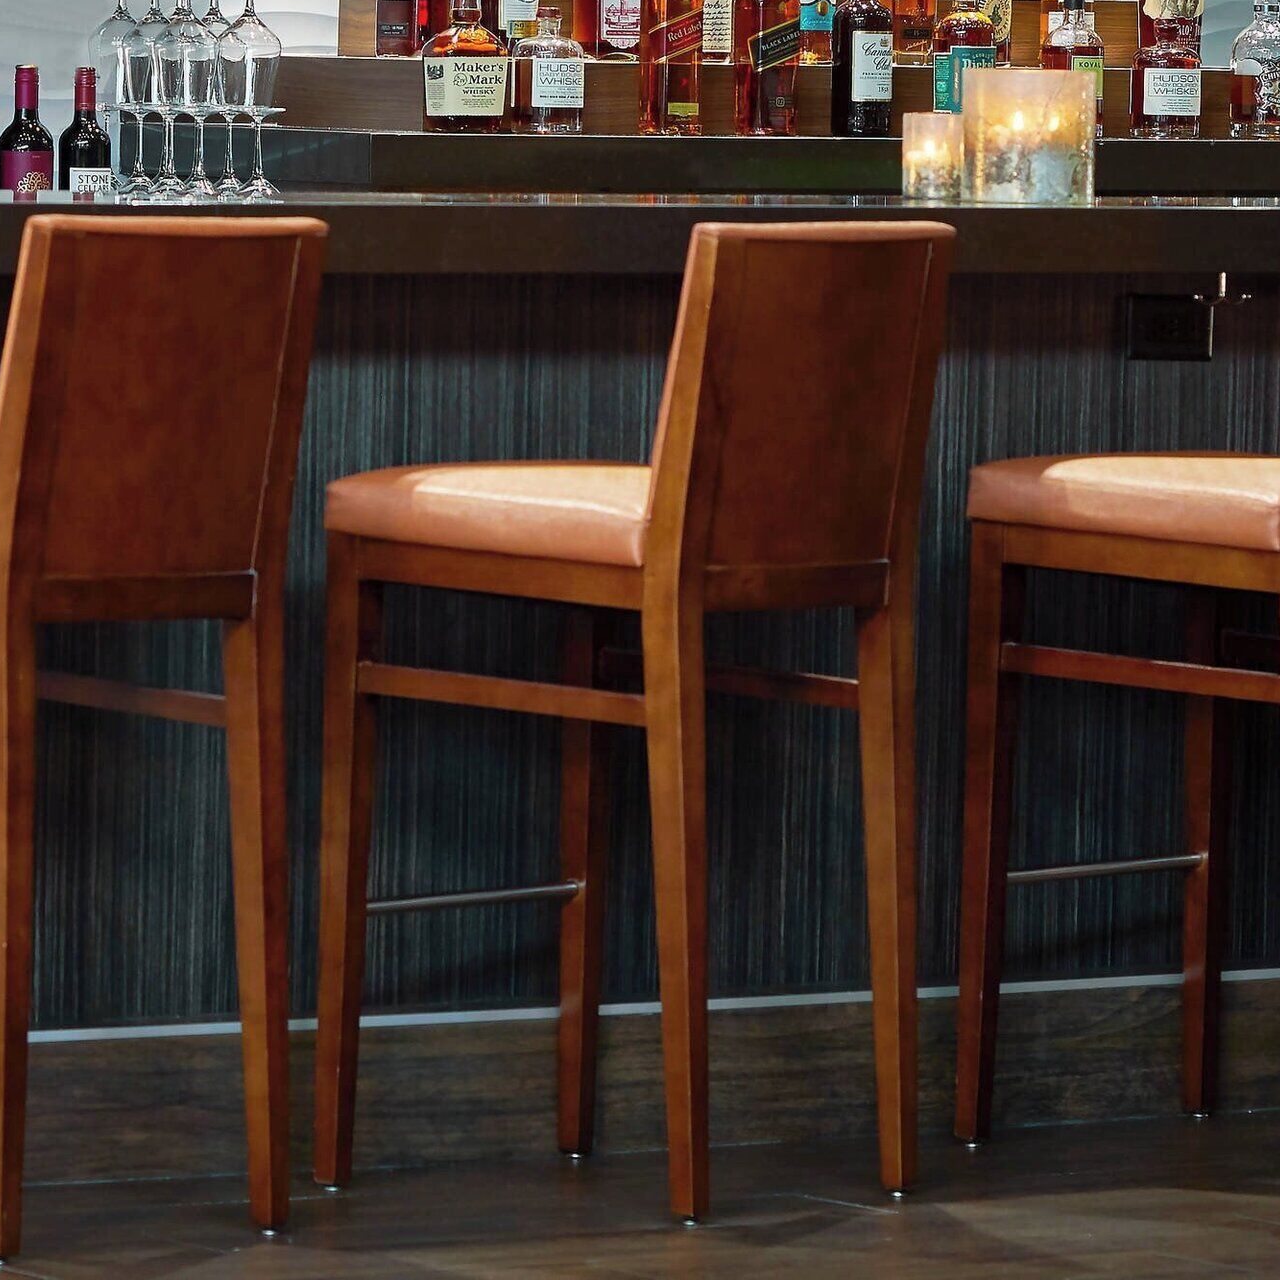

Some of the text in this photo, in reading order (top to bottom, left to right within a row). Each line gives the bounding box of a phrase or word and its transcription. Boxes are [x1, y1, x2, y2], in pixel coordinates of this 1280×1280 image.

[668, 31, 684, 43] Red
[683, 23, 702, 37] Label
[762, 39, 781, 51] BLACK
[453, 62, 504, 73] Maker's
[468, 74, 504, 85] Mark
[1153, 75, 1200, 83] HUDSON
[78, 175, 110, 184] STONE
